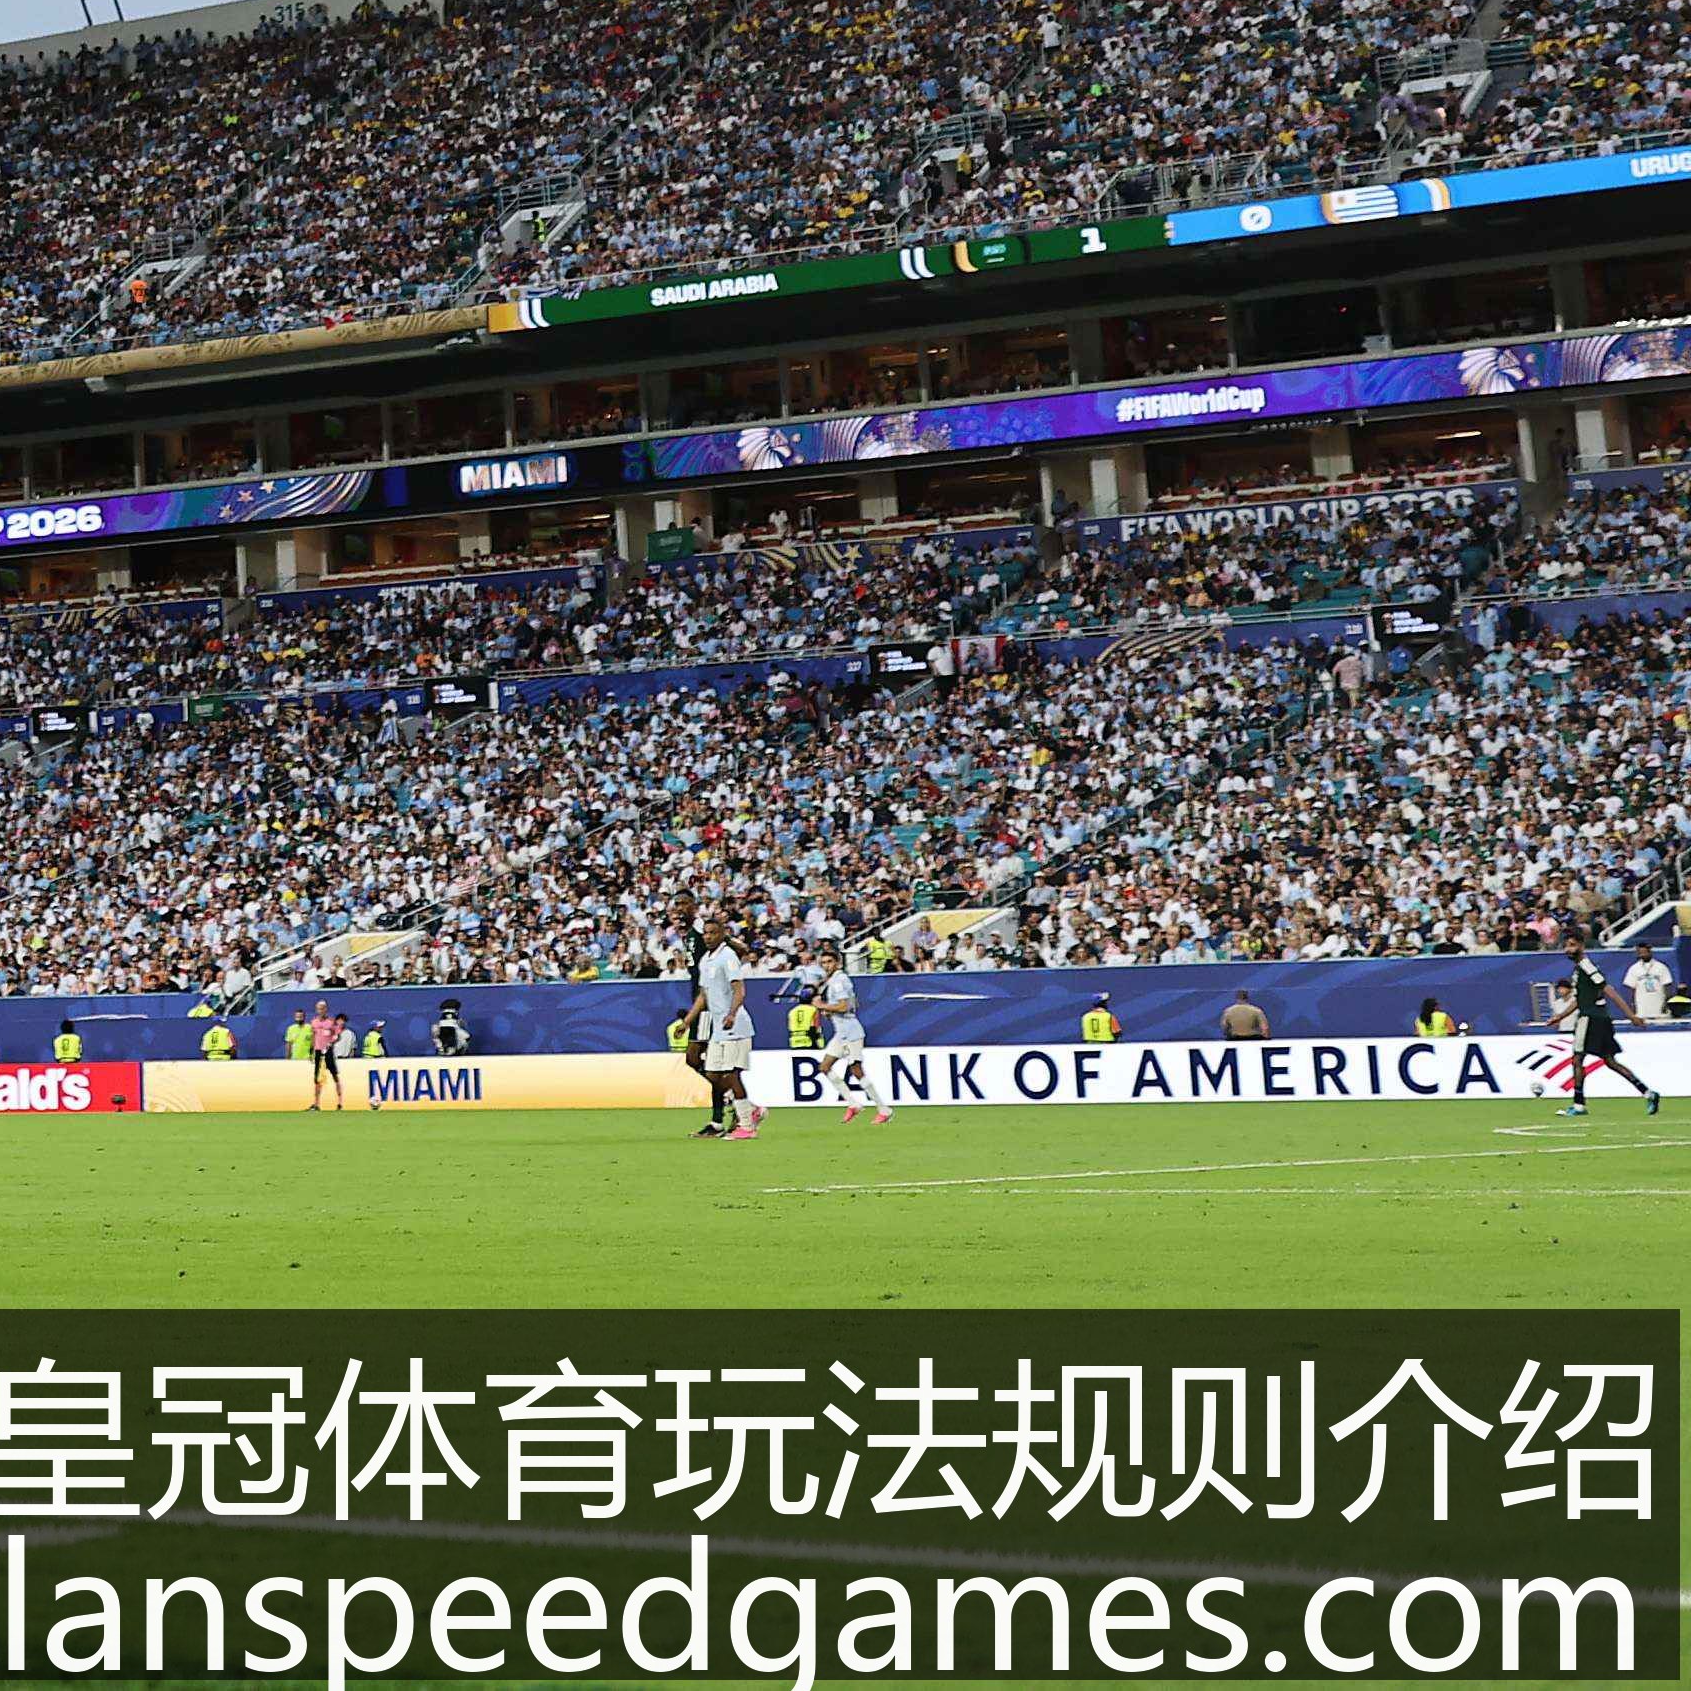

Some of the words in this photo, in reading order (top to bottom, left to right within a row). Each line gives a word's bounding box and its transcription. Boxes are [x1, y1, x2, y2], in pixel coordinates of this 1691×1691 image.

[650, 279, 707, 306] SAUDI
[708, 272, 779, 299] ARABIA
[1116, 385, 1266, 423] #FIFAWorldCup
[459, 454, 568, 494] MIAMI
[6, 504, 103, 540] 2026
[368, 1066, 483, 1103] MIAMI
[1014, 1047, 1101, 1102] OF
[1132, 1042, 1502, 1099] AMERICA
